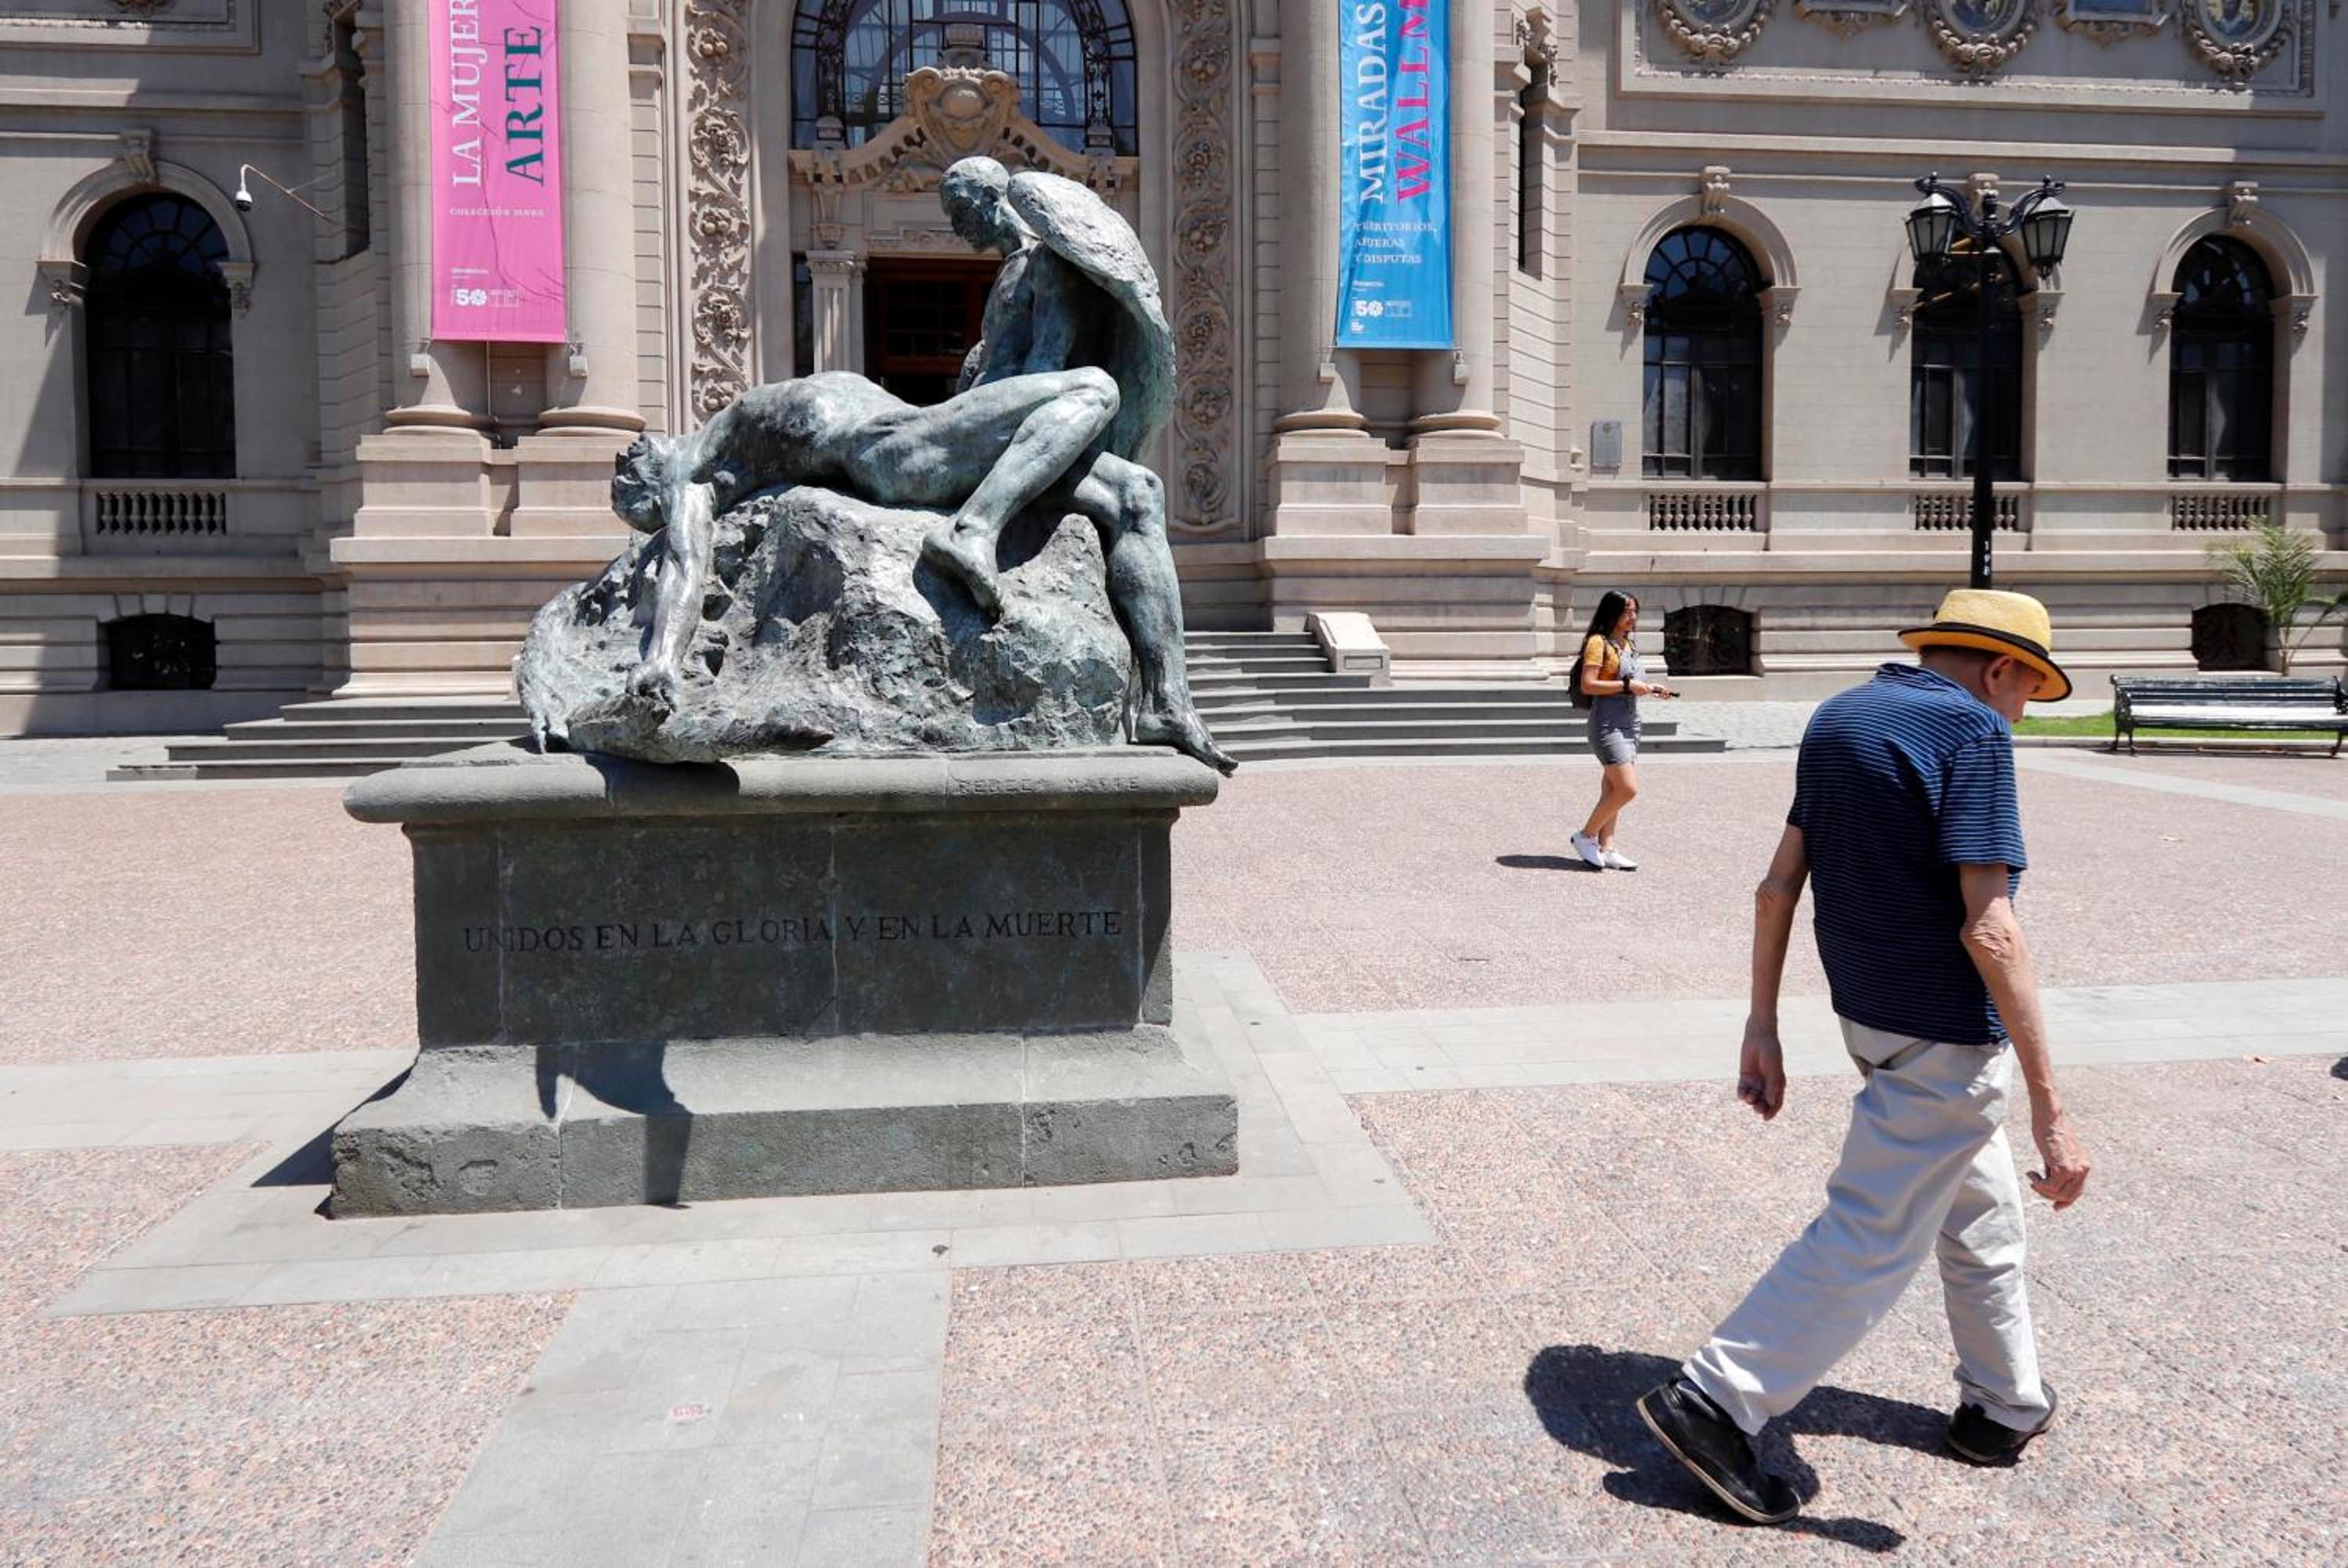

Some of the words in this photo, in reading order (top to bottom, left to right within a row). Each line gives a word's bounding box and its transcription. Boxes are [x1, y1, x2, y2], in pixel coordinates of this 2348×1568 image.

[450, 0, 488, 128] MUJER
[503, 26, 545, 187] ARTE
[1356, 2, 1387, 203] MIRADAS
[452, 135, 481, 187] LA
[463, 926, 585, 952] UNIDOS
[596, 924, 639, 950] EN
[653, 922, 697, 948] LA
[711, 917, 833, 945] GLORIA
[843, 915, 870, 941] Y
[878, 914, 921, 940] EN
[931, 915, 976, 939] LA
[985, 910, 1123, 939] MUERTE
